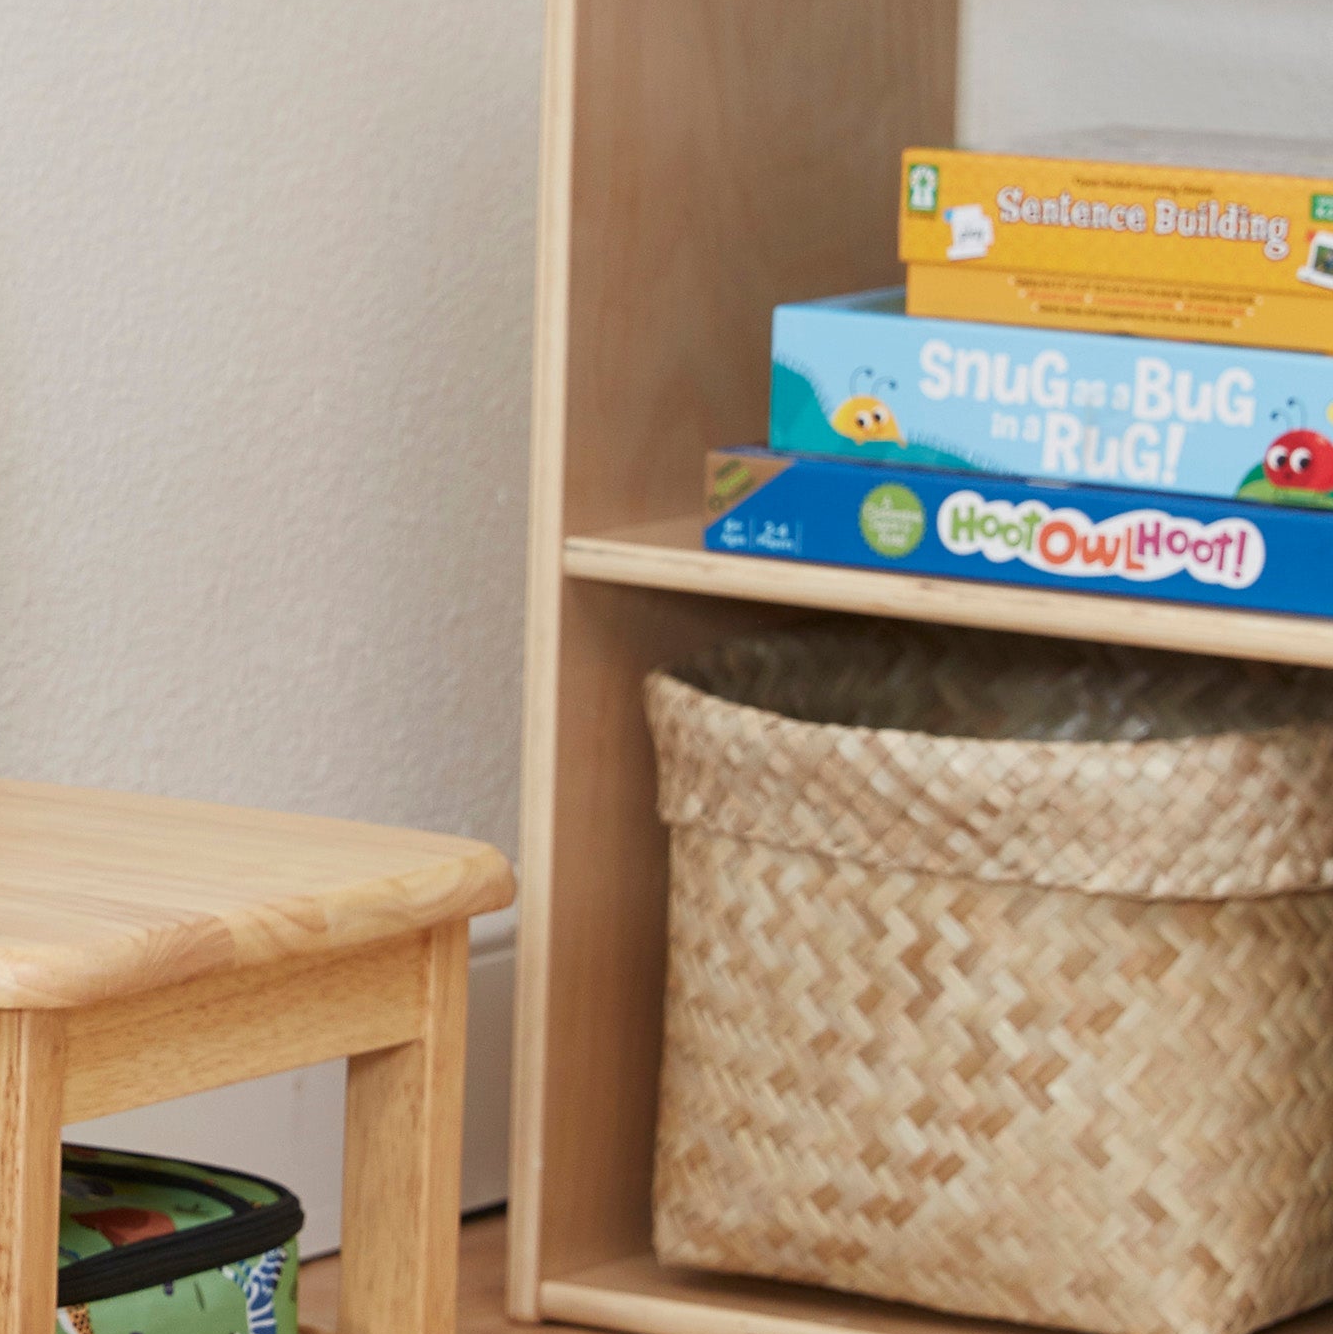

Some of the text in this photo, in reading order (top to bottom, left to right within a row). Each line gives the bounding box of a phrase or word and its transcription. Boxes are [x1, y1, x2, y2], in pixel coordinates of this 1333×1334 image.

[996, 186, 1147, 233] Sentence
[1154, 198, 1290, 261] Building
[1072, 379, 1107, 408] as
[1111, 382, 1130, 411] a
[991, 411, 1019, 440] in
[1022, 414, 1041, 442] a
